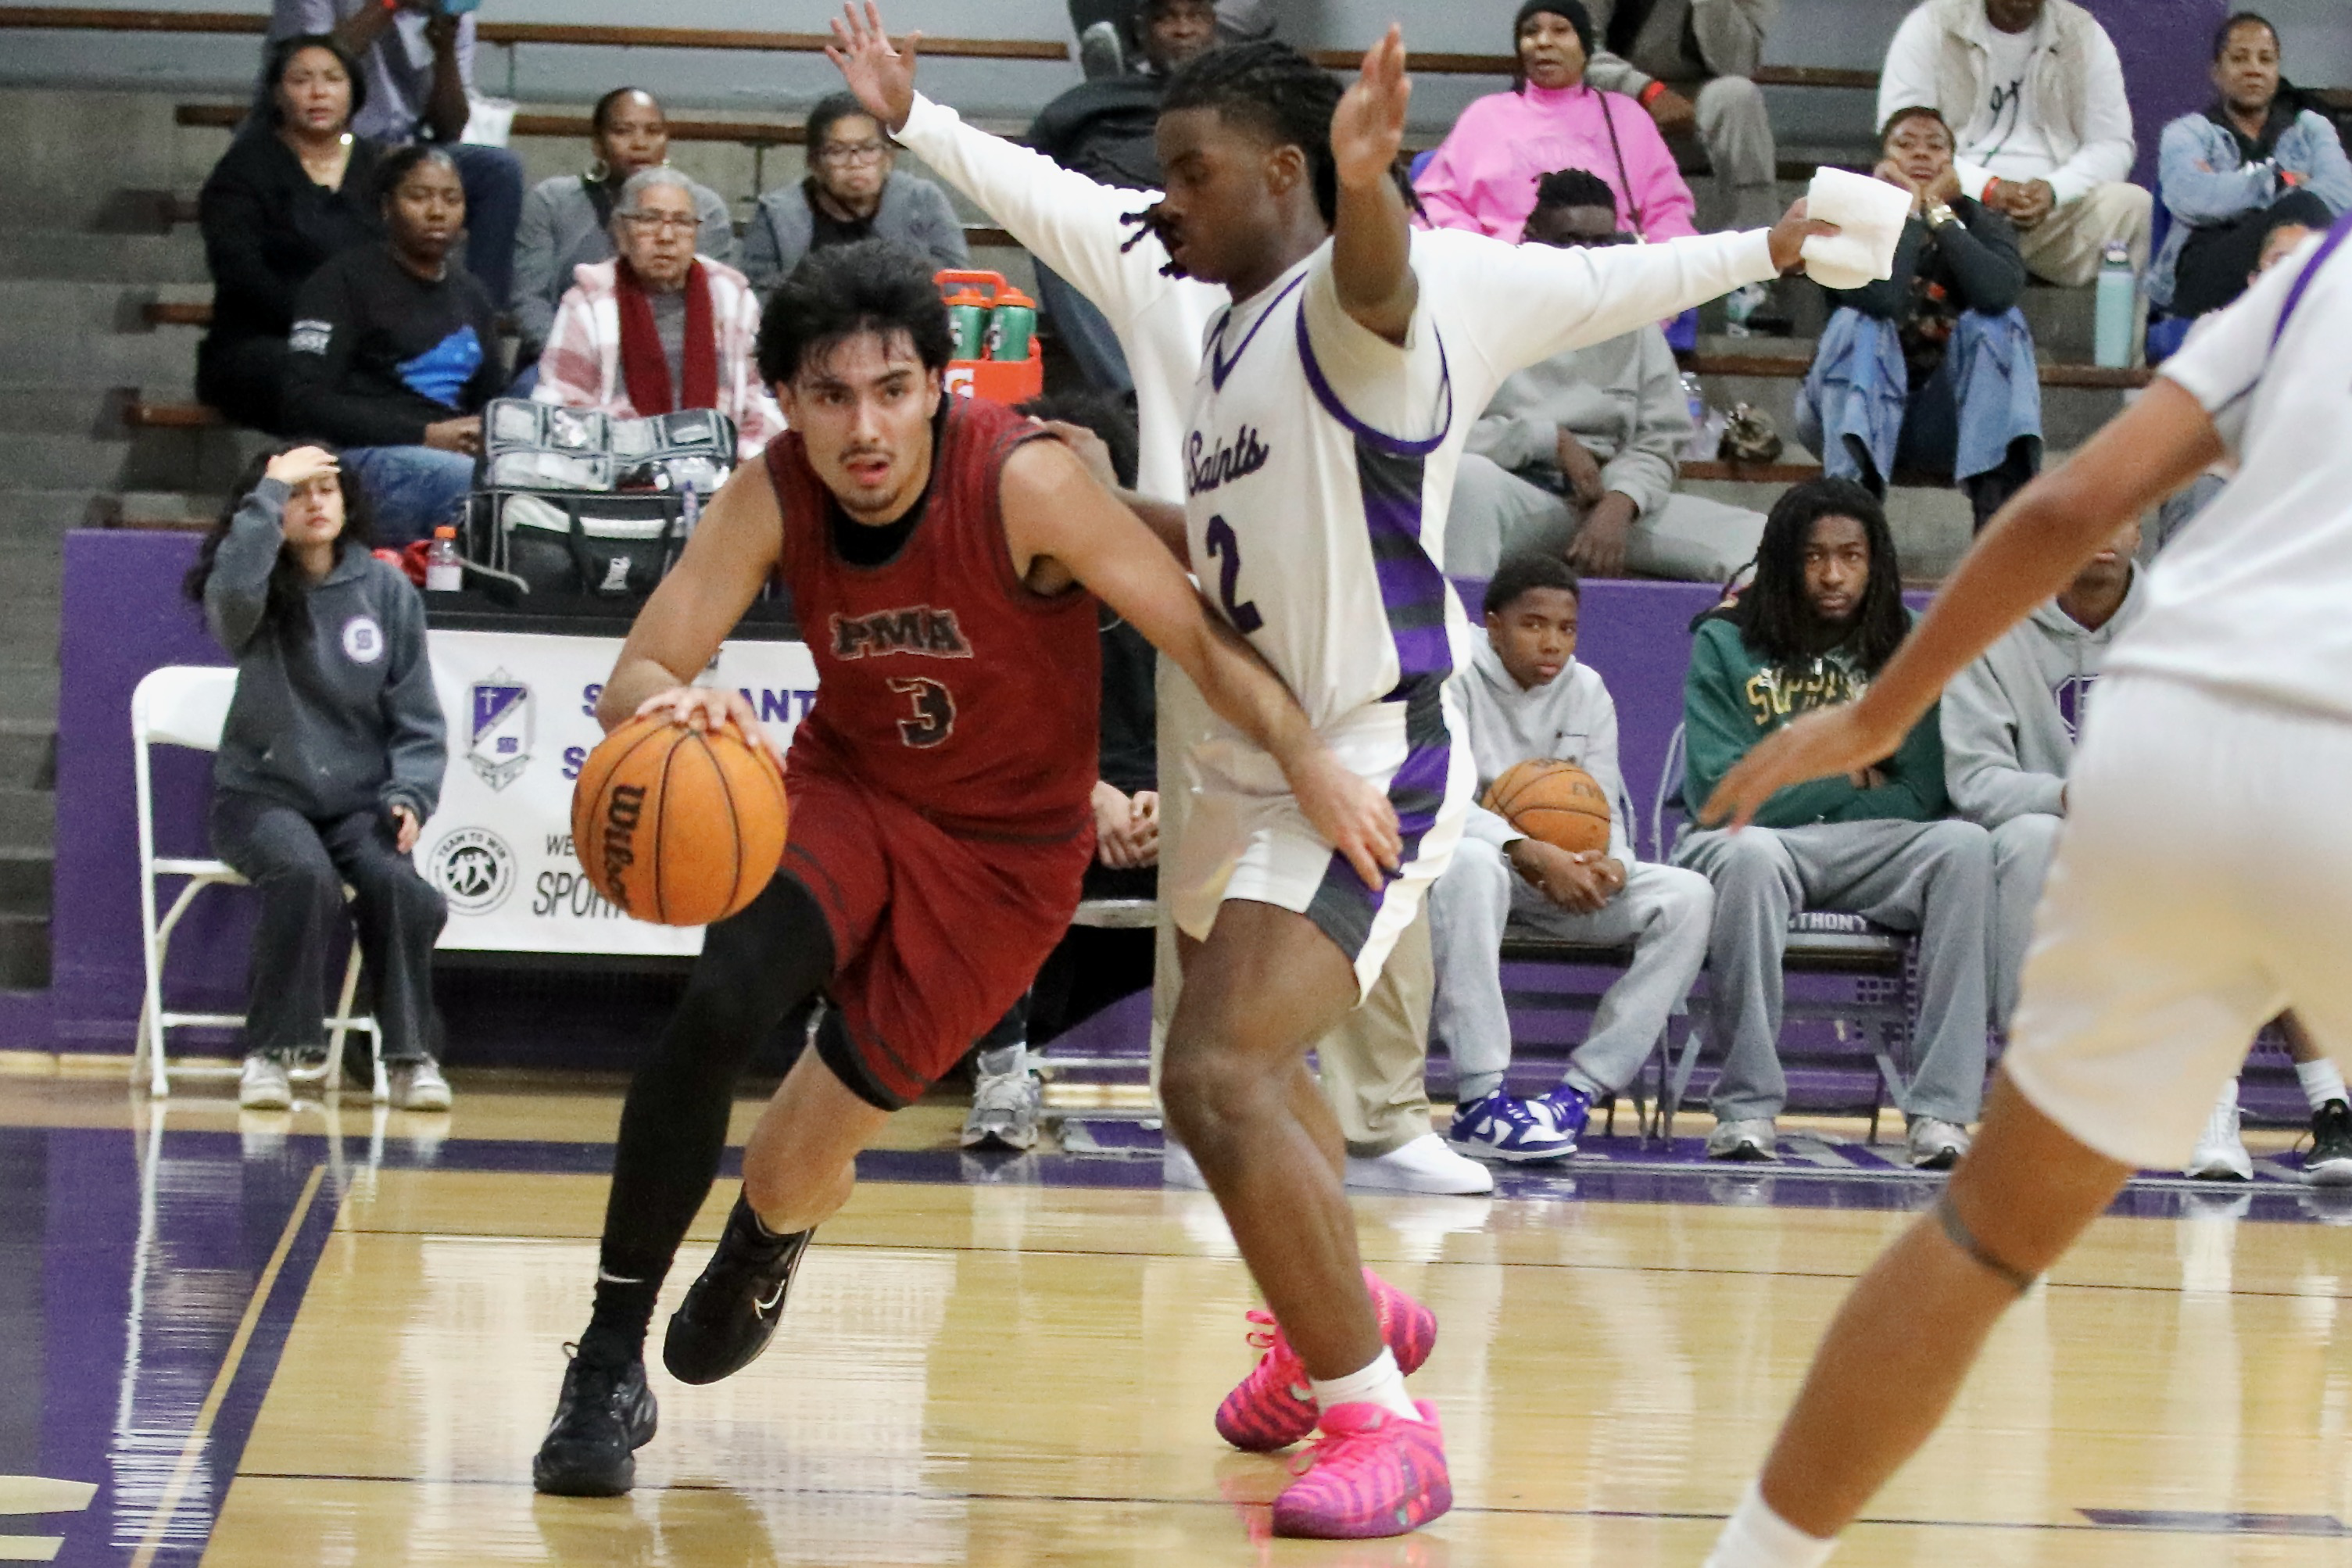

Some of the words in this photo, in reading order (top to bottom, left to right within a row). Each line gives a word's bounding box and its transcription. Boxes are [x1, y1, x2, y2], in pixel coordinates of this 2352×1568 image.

[1185, 424, 1270, 497] Saints
[1206, 514, 1264, 634] 2
[829, 603, 975, 661] PMA
[885, 676, 957, 749] 3
